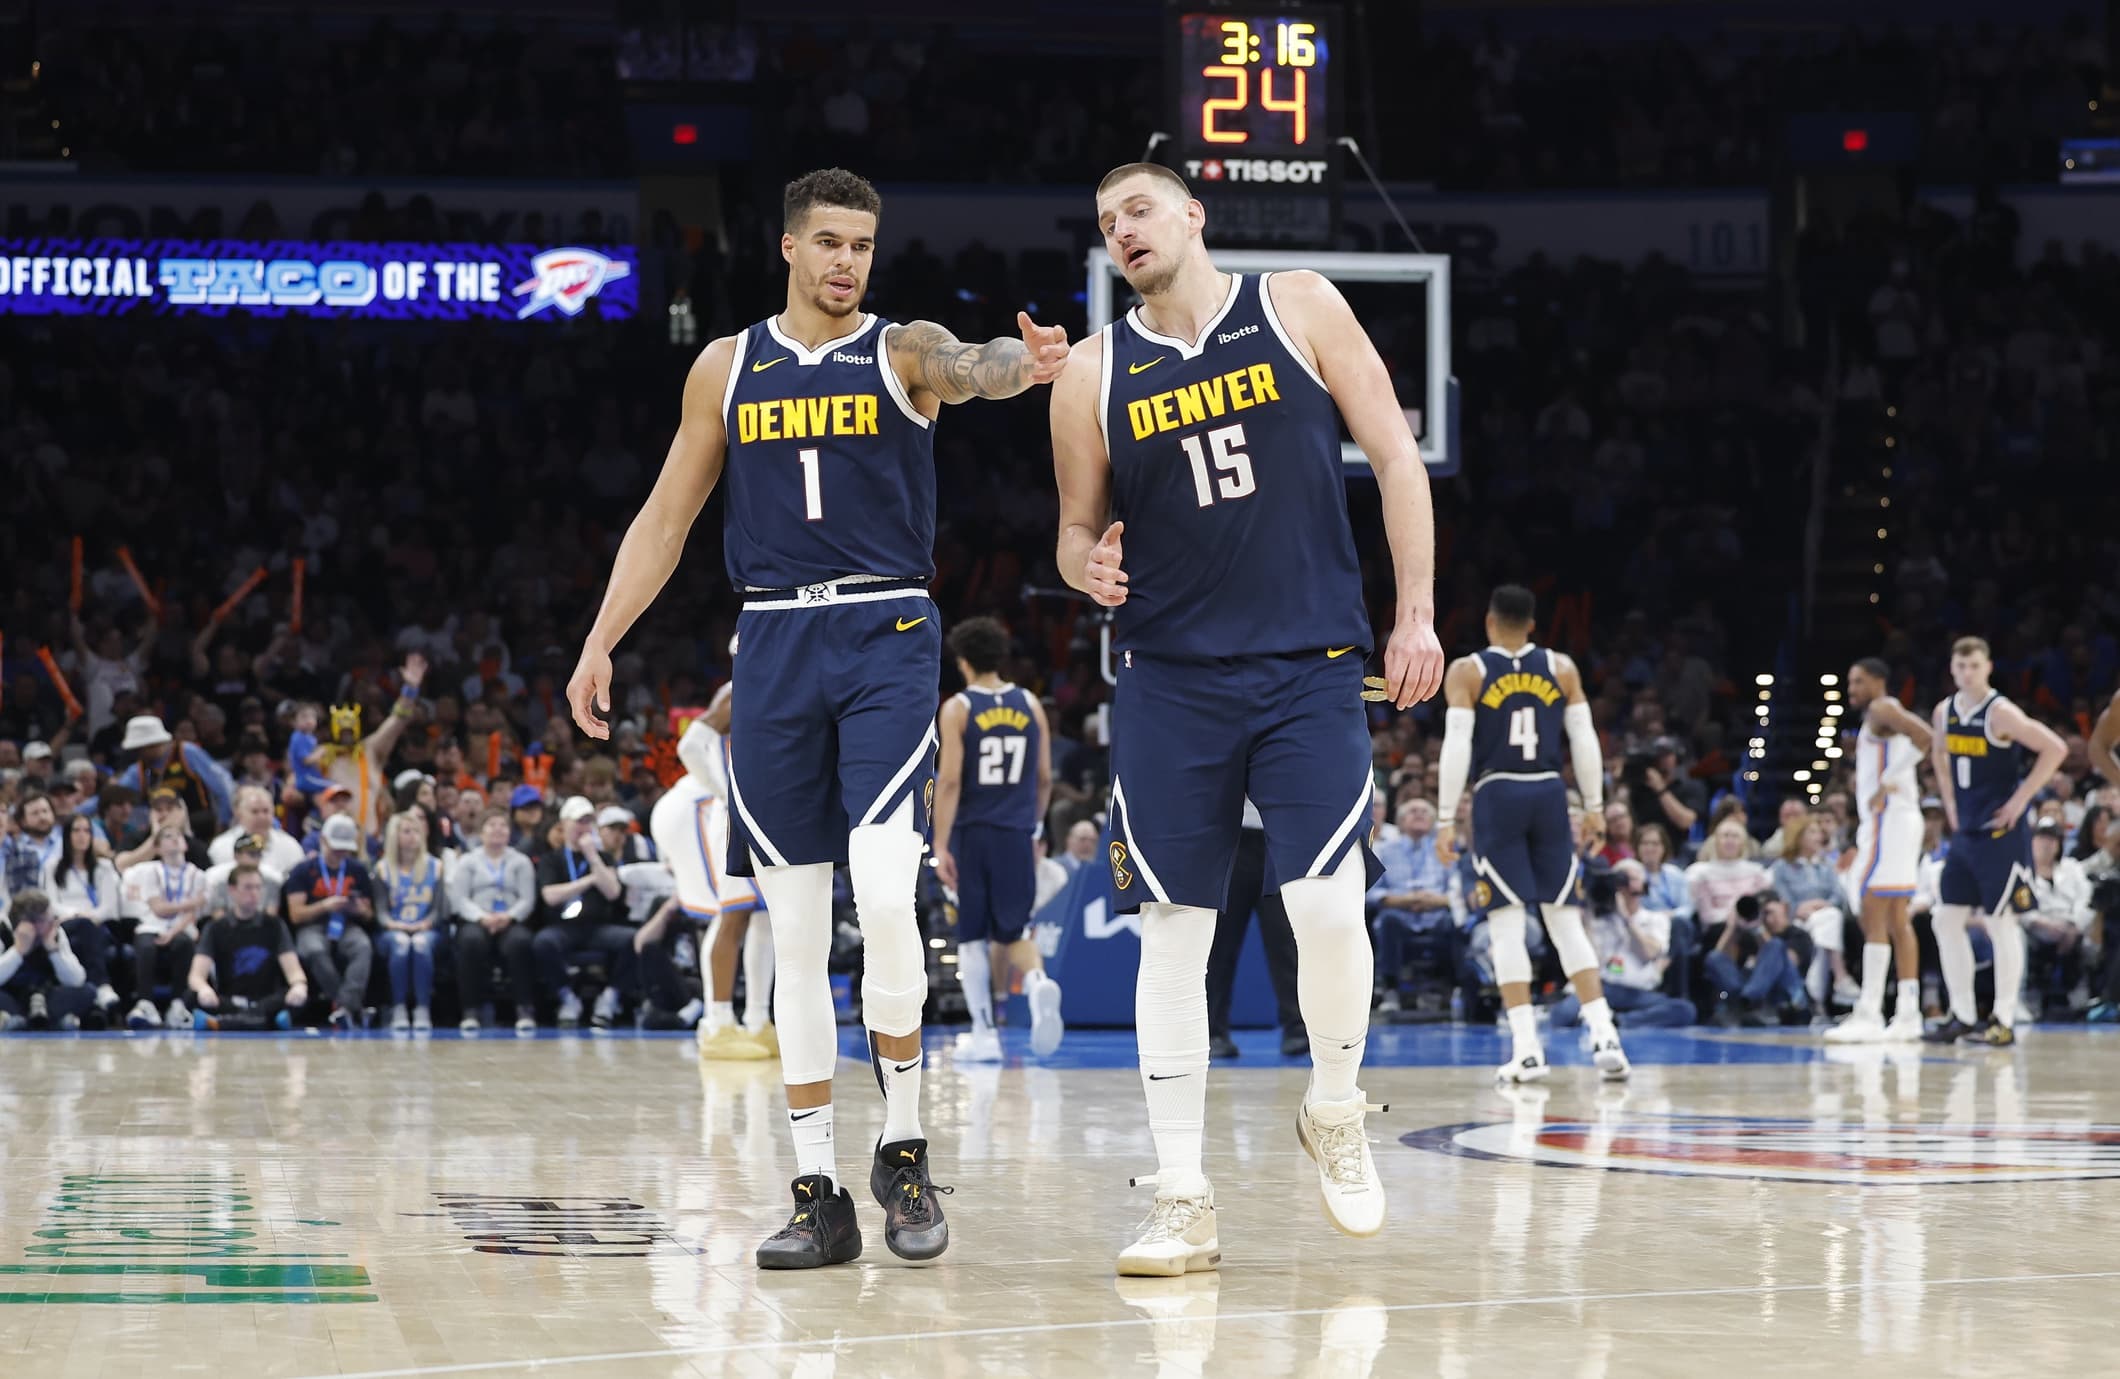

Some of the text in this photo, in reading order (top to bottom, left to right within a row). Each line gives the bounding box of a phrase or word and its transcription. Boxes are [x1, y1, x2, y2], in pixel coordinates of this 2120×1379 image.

[1202, 66, 1307, 145] 24
[1223, 159, 1328, 184] TISSOT
[159, 258, 377, 306] TACO
[383, 261, 426, 300] OF
[434, 262, 500, 301] THE
[832, 352, 873, 365] ibotta
[1217, 324, 1259, 345] ibotta
[737, 394, 879, 444] DENVER
[1126, 362, 1281, 442] DENVER
[799, 448, 824, 521] 1
[1180, 423, 1257, 508] 15
[1508, 706, 1539, 761] 4
[978, 735, 1027, 785] 27
[22, 1173, 349, 1257] paycom
